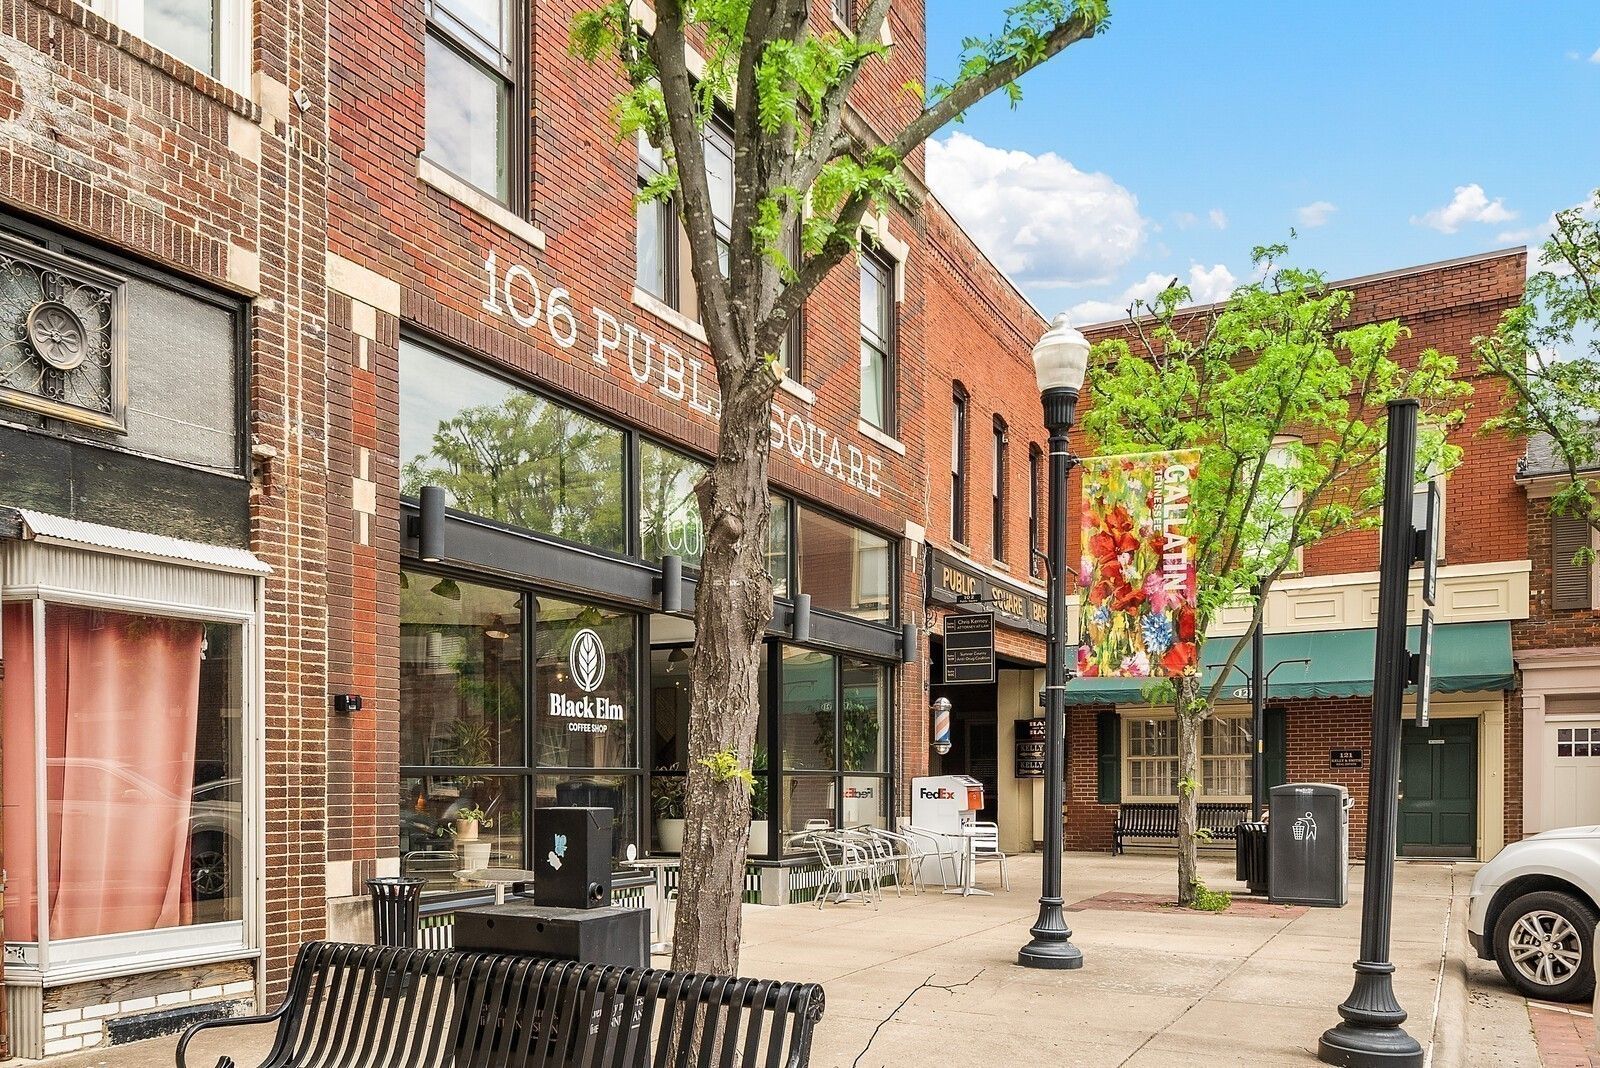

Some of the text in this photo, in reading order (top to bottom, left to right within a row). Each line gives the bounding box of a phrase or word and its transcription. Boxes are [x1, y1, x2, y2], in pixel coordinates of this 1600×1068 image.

[481, 250, 883, 498] 106 PUBL SQUARE
[1153, 468, 1163, 532] TENNESSEE
[1162, 464, 1190, 591] GALLATIN
[943, 567, 1048, 625] PUBLIC SQUARE BAR
[550, 693, 624, 720] Black Elm
[568, 722, 608, 733] COFFEE SHOP
[1020, 744, 1044, 752] KELLY
[1020, 761, 1044, 769] KELLY
[920, 787, 955, 800] FedEx
